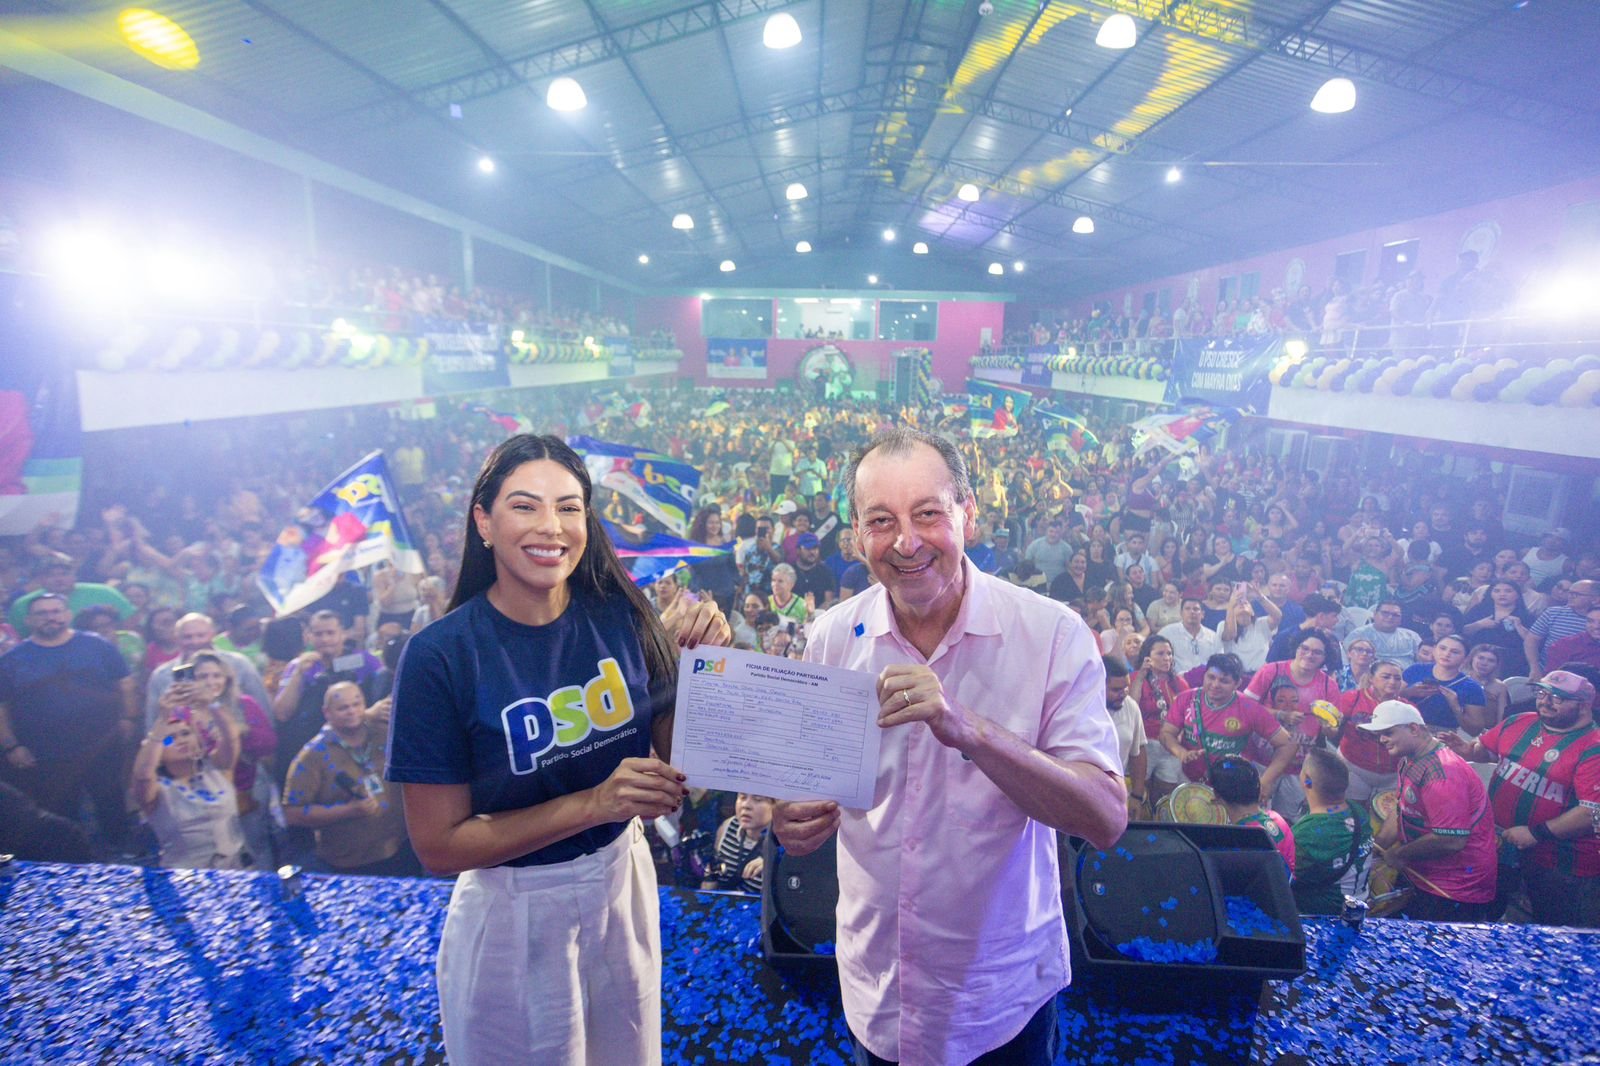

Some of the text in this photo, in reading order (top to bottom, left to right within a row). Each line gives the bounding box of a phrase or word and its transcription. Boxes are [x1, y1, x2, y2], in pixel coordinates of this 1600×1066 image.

[1204, 350, 1217, 368] PSD
[1216, 350, 1243, 368] CRESCE
[1192, 371, 1204, 389] COM
[1204, 372, 1225, 390] MAYRA
[693, 658, 726, 675] psd
[746, 663, 762, 671] FICHA
[771, 667, 795, 677] FILIAÇÃO
[797, 671, 828, 681] PARTIDÁRIA
[501, 657, 634, 776] psd
[541, 727, 637, 768] Partido Social Democrático
